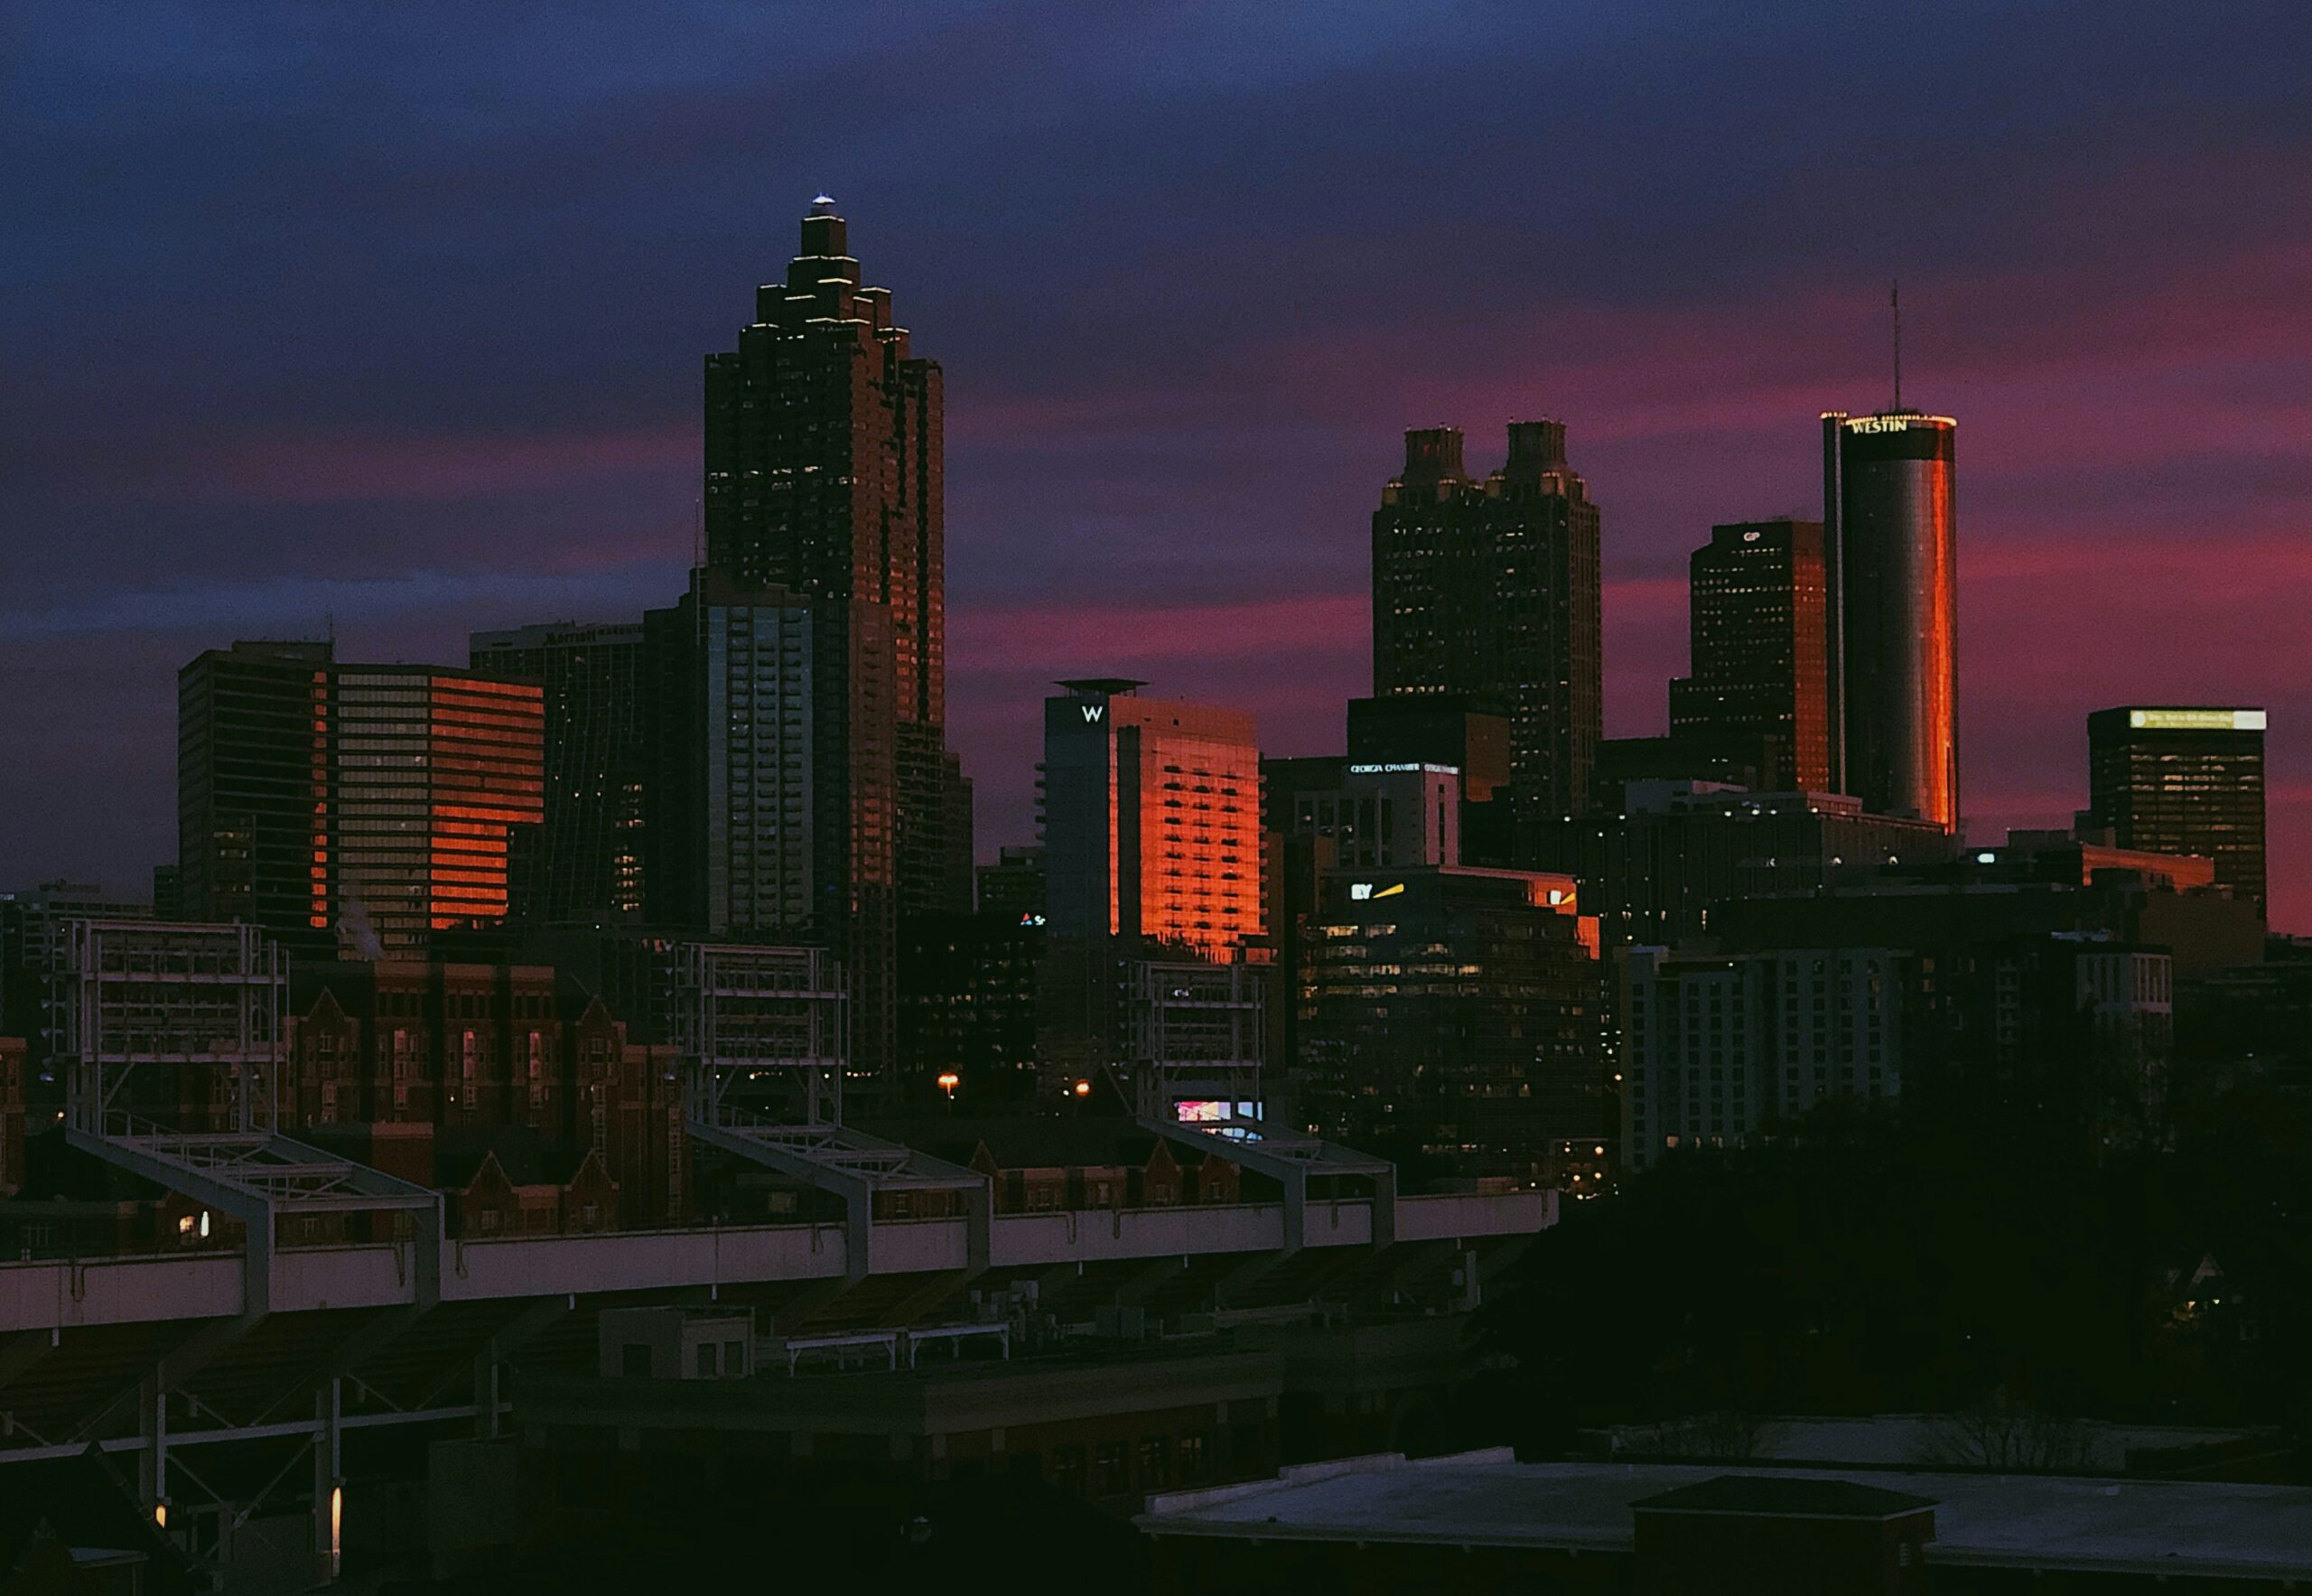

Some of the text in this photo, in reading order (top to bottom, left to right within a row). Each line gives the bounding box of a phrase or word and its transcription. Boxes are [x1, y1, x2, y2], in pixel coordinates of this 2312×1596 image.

[1851, 420, 1907, 434] WESTIN
[1081, 705, 1104, 723] W
[1350, 764, 1384, 773] GEORGIA
[1351, 883, 1373, 900] EY
